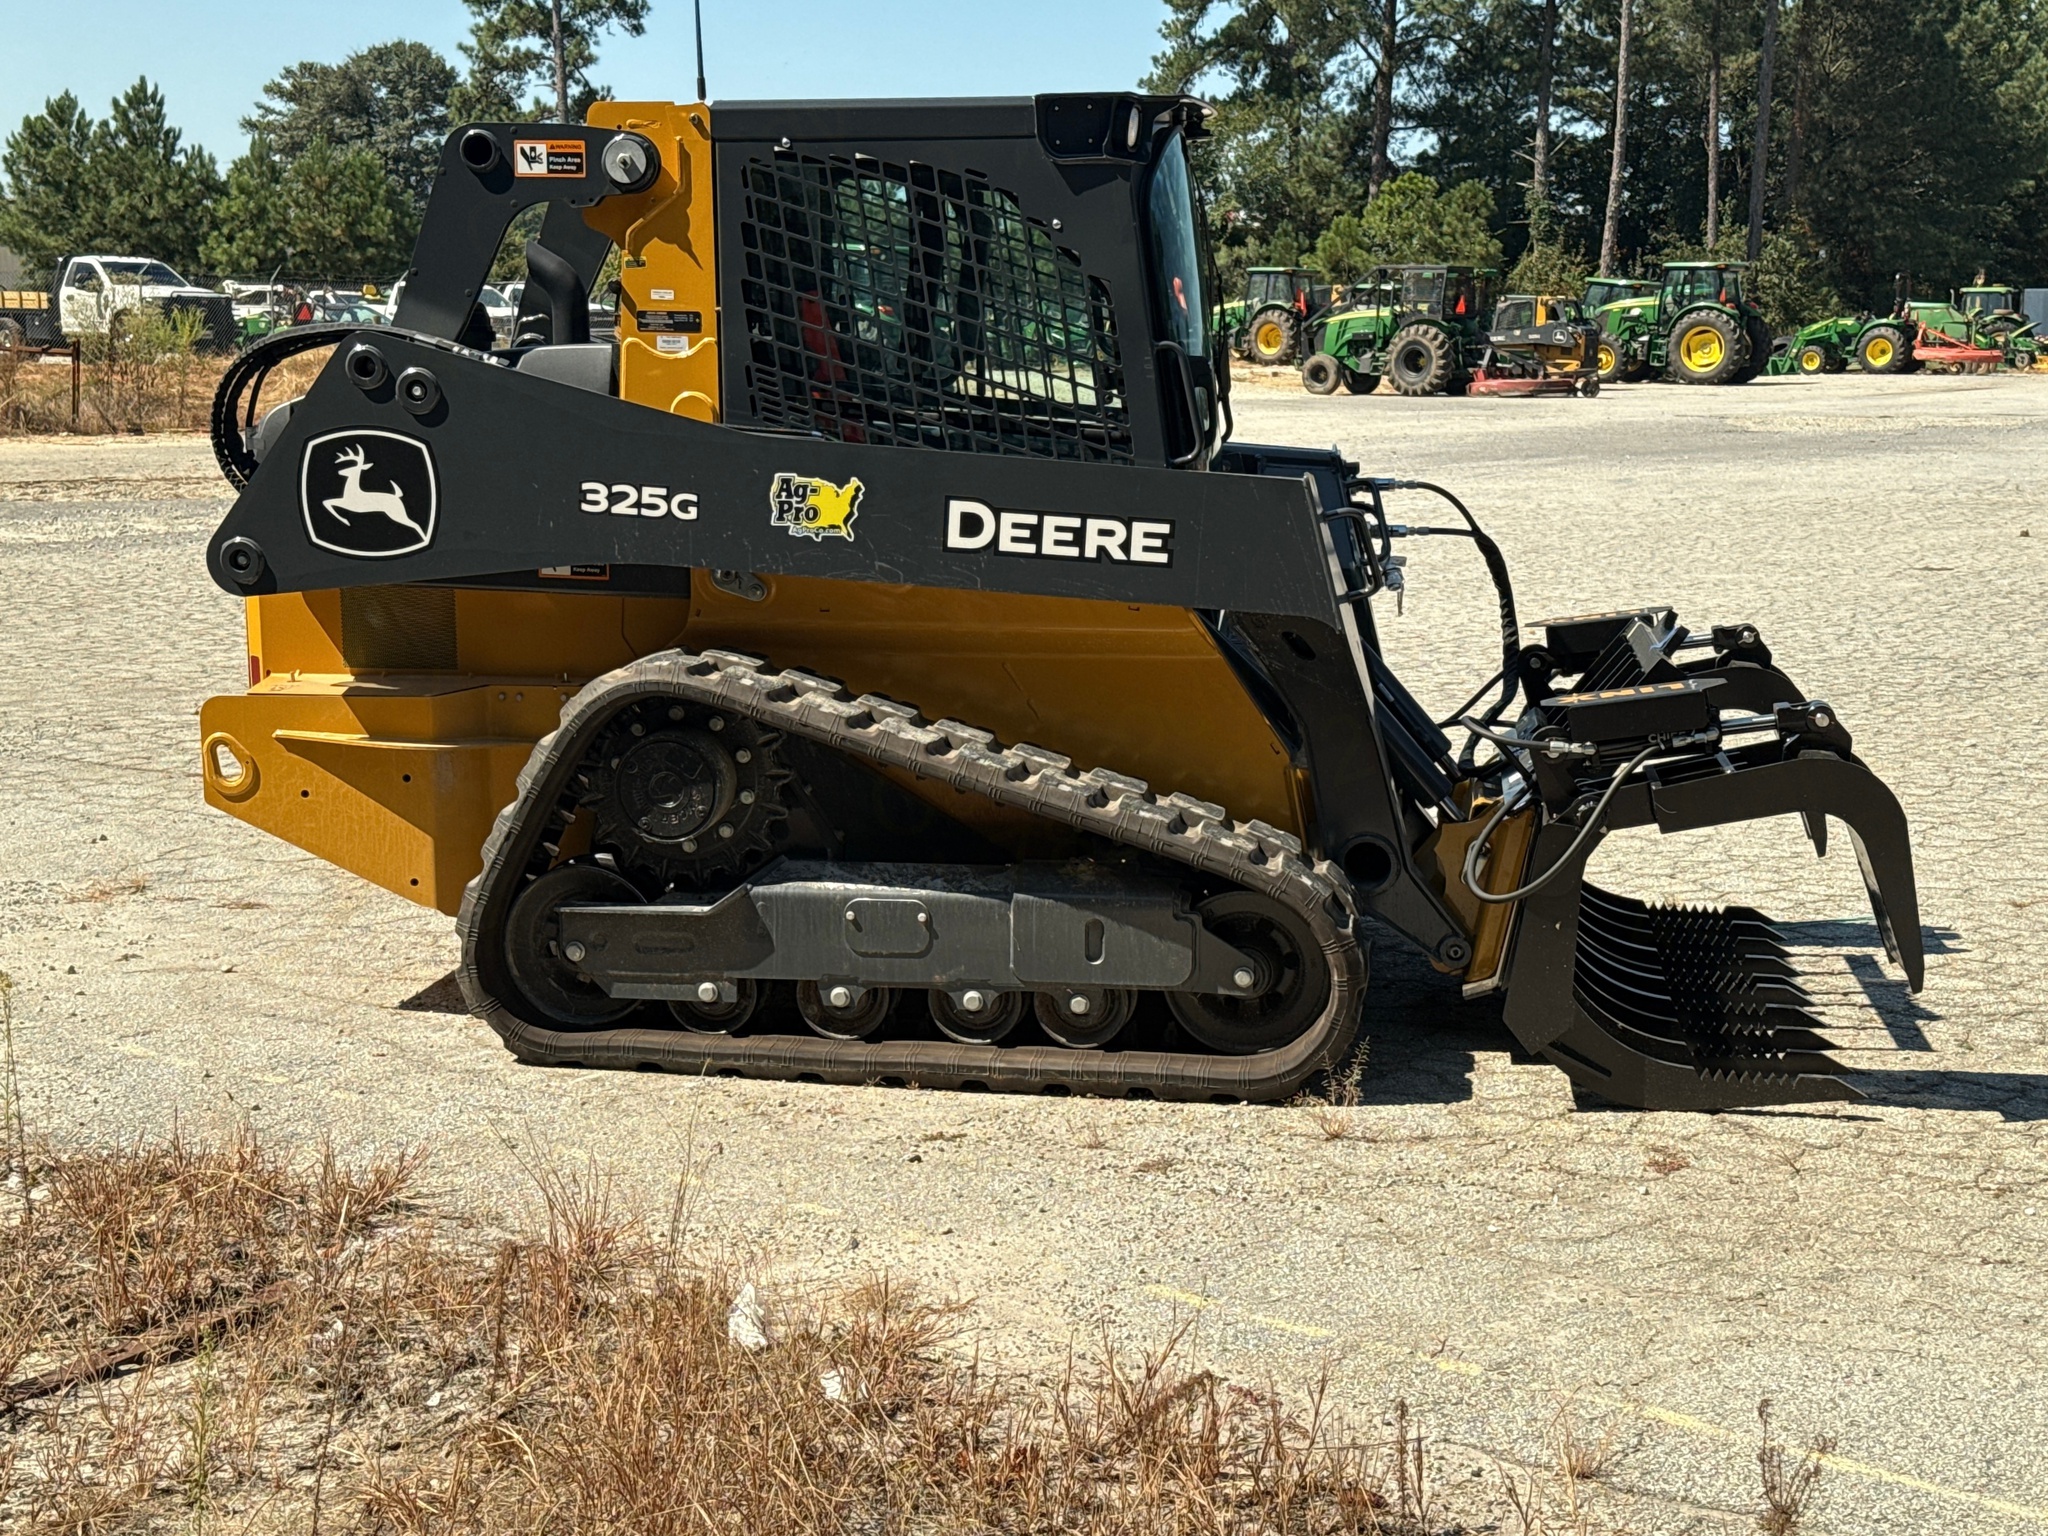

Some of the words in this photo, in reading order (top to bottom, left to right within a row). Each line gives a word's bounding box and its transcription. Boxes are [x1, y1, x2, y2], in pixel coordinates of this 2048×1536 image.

[580, 481, 698, 520] 325G
[775, 478, 818, 505] Ag-
[776, 501, 820, 523] Pro
[792, 526, 841, 535] AgProCo.com
[947, 500, 1171, 564] DEERE
